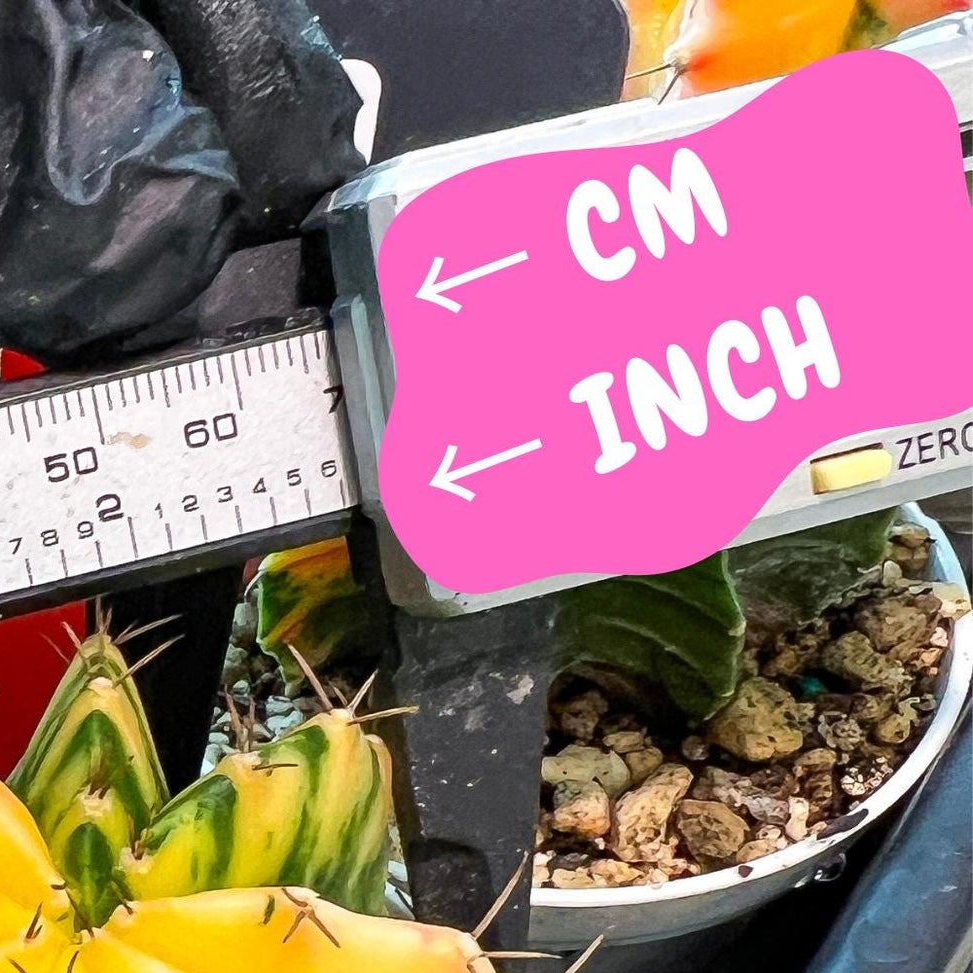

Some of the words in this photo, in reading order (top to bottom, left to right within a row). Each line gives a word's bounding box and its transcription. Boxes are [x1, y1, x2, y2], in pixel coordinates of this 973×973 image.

[44, 447, 98, 482] 50
[184, 413, 237, 448] 60
[9, 537, 22, 554] 7
[41, 529, 59, 547] 8
[77, 521, 93, 539] 9
[96, 494, 124, 522] 2
[182, 495, 199, 512] 2
[217, 486, 233, 502] 3
[253, 478, 266, 493] 4
[287, 469, 301, 486] 5
[321, 460, 337, 477] 6
